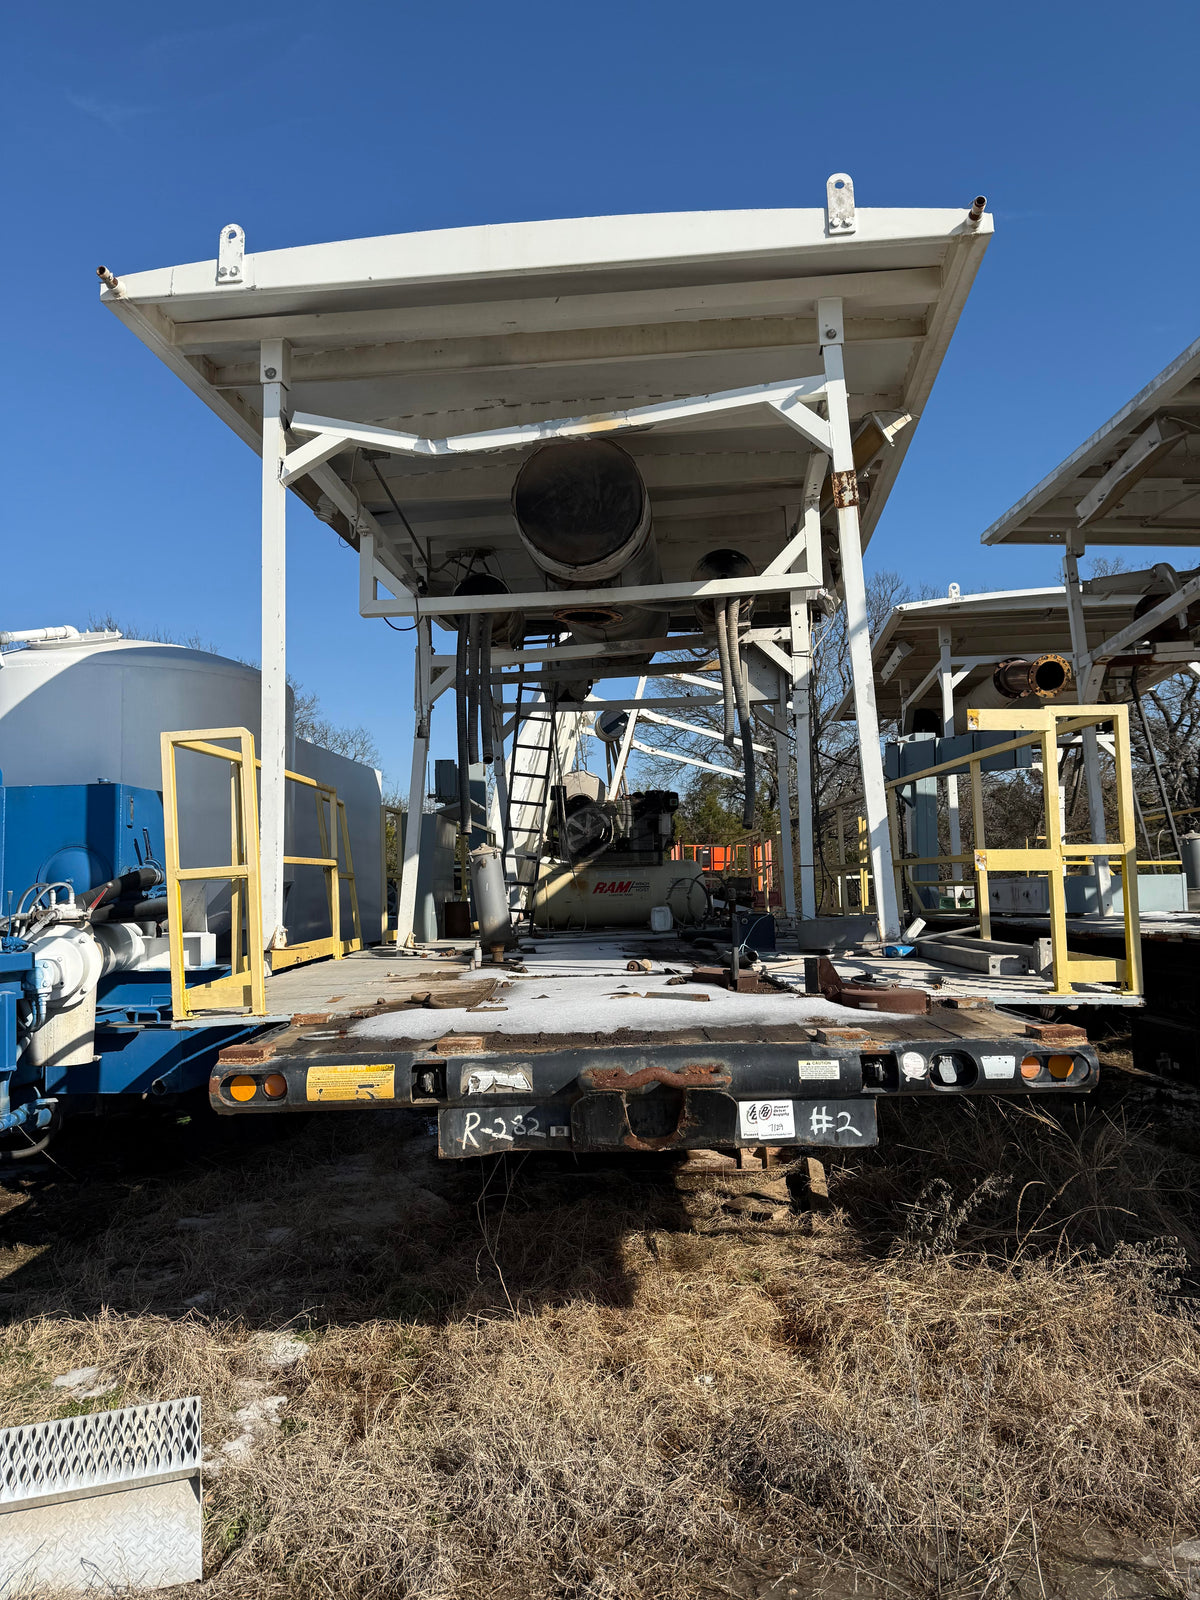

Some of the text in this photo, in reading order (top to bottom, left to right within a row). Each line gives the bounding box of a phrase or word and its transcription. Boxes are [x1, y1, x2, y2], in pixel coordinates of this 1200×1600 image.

[592, 881, 632, 894] RAM
[461, 1112, 547, 1150] R-282
[809, 1106, 862, 1136] #2
